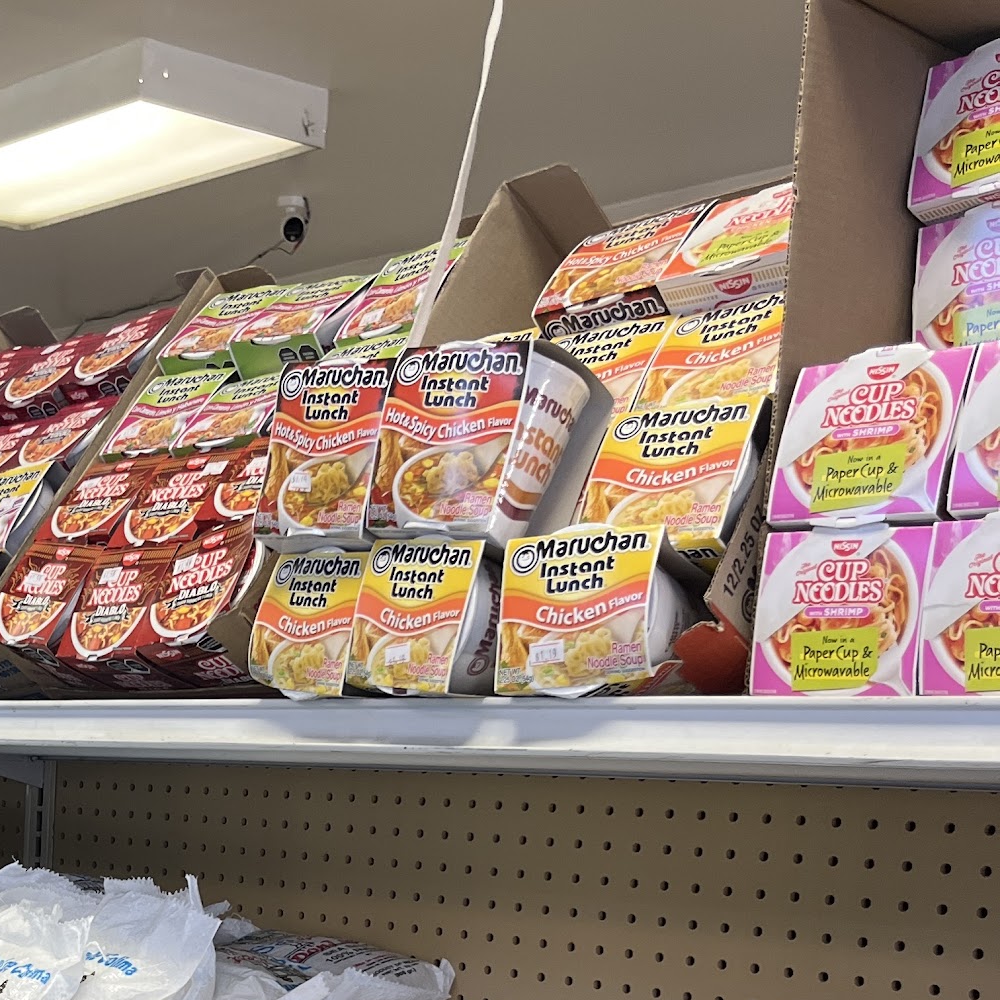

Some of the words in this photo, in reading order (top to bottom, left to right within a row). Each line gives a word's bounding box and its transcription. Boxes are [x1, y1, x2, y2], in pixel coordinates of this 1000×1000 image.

[965, 139, 997, 158] Paper
[612, 240, 660, 261] Chicken
[717, 276, 750, 291] NISSIN
[227, 287, 288, 302] Maruchan
[219, 307, 251, 317] Lunch
[221, 299, 262, 310] Instant
[563, 297, 661, 332] Maruchan
[700, 309, 772, 335] Instant
[702, 324, 757, 344] Lunch
[684, 339, 754, 366] Chicken
[421, 350, 521, 375] Maruchan
[747, 364, 776, 377] Ramen
[165, 371, 223, 388] Maruchan
[302, 366, 387, 388] Maruchan
[421, 375, 489, 391] Instant
[157, 391, 190, 404] Lunch
[160, 384, 200, 396] Instant
[302, 390, 359, 405] Instant
[850, 381, 905, 404] CUP
[424, 393, 476, 408] Lunch
[305, 406, 348, 421] Lunch
[639, 403, 748, 429] Maruchan
[821, 397, 917, 428] NOODLES
[437, 418, 485, 440] Chicken
[487, 416, 512, 428] Flavor
[638, 426, 714, 444] Instant
[852, 425, 893, 437] SHRIMP
[316, 430, 355, 451] Chicken
[357, 428, 378, 439] Flavor
[641, 442, 699, 458] Lunch
[625, 465, 697, 487] Chicken
[699, 458, 736, 476] Flavor
[826, 465, 858, 482] Paper
[860, 464, 884, 479] Cup
[148, 482, 208, 503] NOODLES
[813, 478, 893, 503] Microwavable
[152, 498, 190, 511] DIABLO
[692, 503, 721, 513] Ramen
[664, 515, 694, 526] Noodle
[392, 542, 470, 568] Maruchan
[538, 531, 647, 561] Maruchan
[293, 556, 360, 577] Maruchan
[389, 566, 444, 584] Instant
[540, 556, 615, 578] Instant
[817, 559, 870, 581] CUP
[170, 560, 234, 595] NOODLES
[288, 577, 337, 593] Instant
[545, 575, 604, 596] Lunch
[23, 593, 50, 606] DIABLO
[89, 585, 142, 606] NOODLES
[179, 582, 219, 600] DIABLO
[391, 582, 433, 600] Lunch
[792, 579, 884, 604] NOODLES
[289, 593, 326, 608] Lunch
[535, 601, 607, 627] Chicken
[608, 590, 643, 609] Flavor
[95, 603, 126, 618] DIABLO
[380, 607, 430, 628] Chicken
[431, 607, 460, 621] Flavor
[823, 606, 864, 617] SHRIMP
[277, 615, 325, 636] Chicken
[326, 615, 352, 627] Flavor
[611, 641, 642, 655] Ramen
[803, 645, 834, 662] Paper
[836, 647, 858, 661] Cup
[587, 655, 617, 669] Noodle
[794, 661, 870, 681] Microwavable
